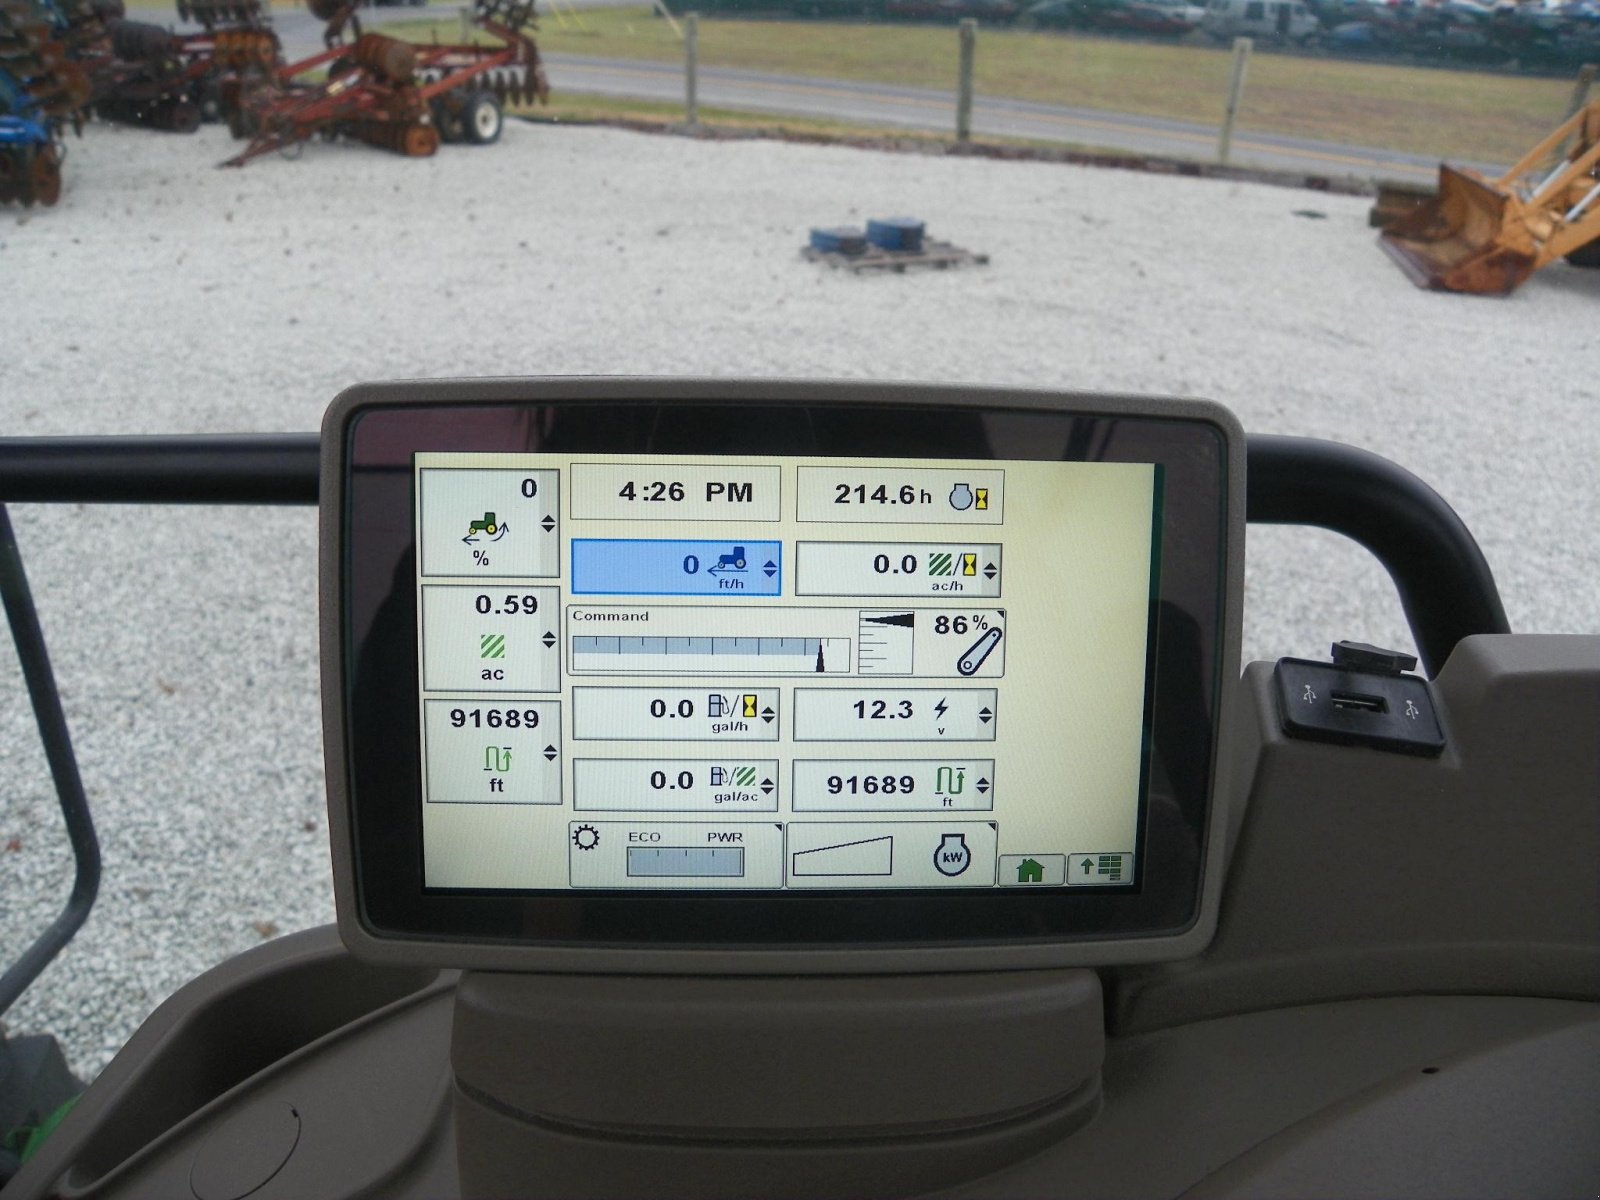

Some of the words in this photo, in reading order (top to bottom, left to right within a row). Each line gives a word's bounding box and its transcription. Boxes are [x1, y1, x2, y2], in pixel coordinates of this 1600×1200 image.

[521, 479, 537, 498] 0
[619, 482, 685, 501] 4:26
[706, 483, 753, 502] PM
[683, 556, 700, 574] 0
[874, 555, 917, 573] 0.0
[932, 581, 963, 591] ac/h
[475, 595, 538, 614] 0.59
[573, 611, 649, 622] Command
[481, 668, 504, 680] ac
[650, 700, 694, 718] 0.0
[853, 700, 913, 719] 12.3
[450, 709, 539, 729] 91689
[712, 721, 748, 733] gal/h
[489, 778, 504, 792] ft
[650, 771, 694, 789] 0.0
[827, 776, 915, 794] 91689
[714, 791, 758, 803] gal/ac
[942, 797, 953, 806] ft
[629, 831, 661, 842] ECO
[707, 832, 743, 842] PWR
